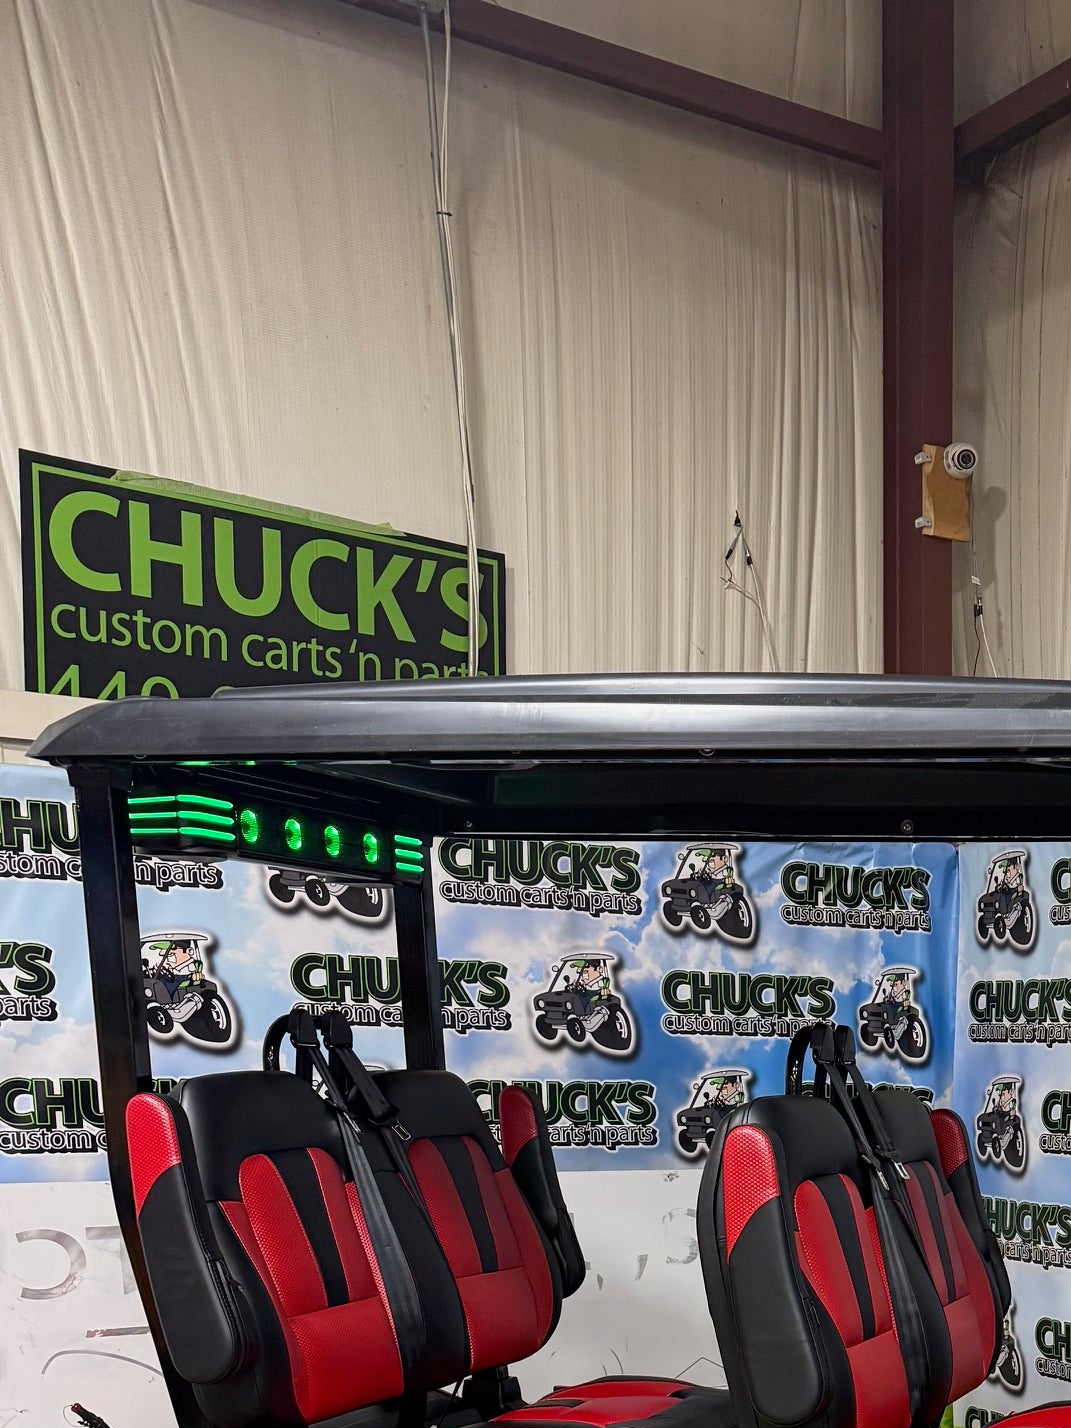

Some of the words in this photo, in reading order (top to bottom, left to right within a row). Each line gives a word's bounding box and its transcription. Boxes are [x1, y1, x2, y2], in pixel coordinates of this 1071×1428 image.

[48, 490, 489, 653] CHUCK'S
[51, 603, 228, 662] custom
[156, 861, 219, 888] parts
[438, 837, 642, 893] CHUCK'S
[440, 881, 516, 903] custom
[589, 890, 639, 913] parts
[781, 861, 931, 911] CHUCK'S
[781, 904, 843, 924] custom
[895, 909, 930, 932] parts
[290, 953, 511, 1007] CHUK'S
[662, 970, 836, 1018] CHUCK'S
[455, 1006, 508, 1031] parts
[664, 1013, 730, 1033] custom
[969, 1022, 1007, 1040] custom
[0, 1128, 93, 1150] custom
[606, 1125, 653, 1148] parts
